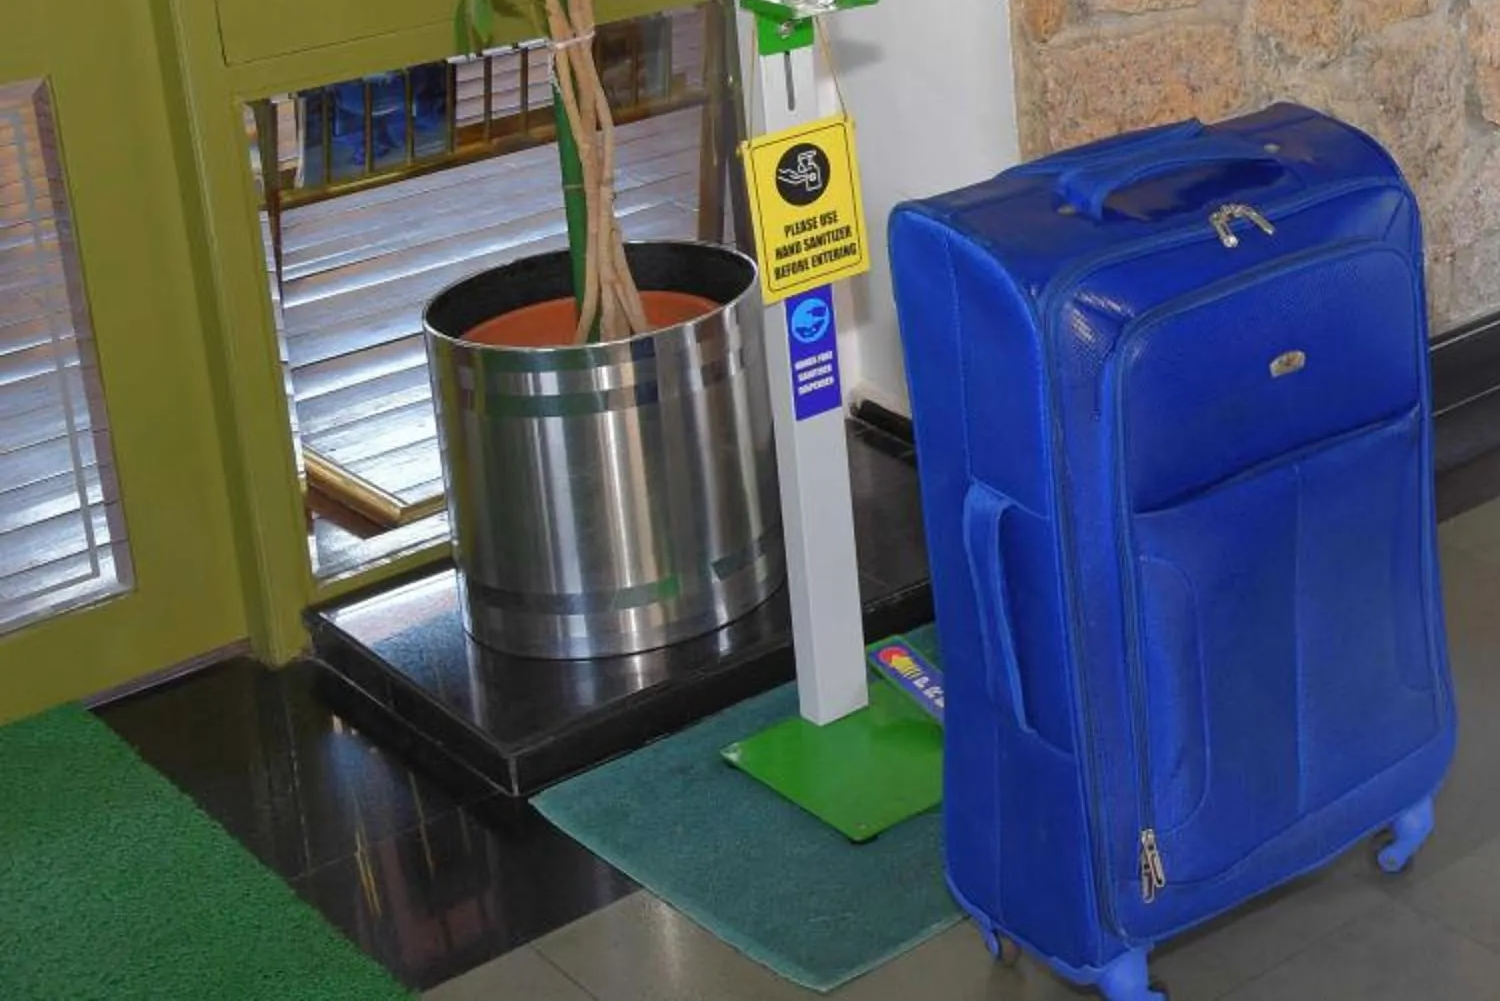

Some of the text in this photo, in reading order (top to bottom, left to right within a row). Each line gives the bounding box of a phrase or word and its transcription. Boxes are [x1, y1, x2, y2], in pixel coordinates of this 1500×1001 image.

[775, 224, 853, 261] HAND SANITIZER
[783, 210, 837, 238] PLEASE USE
[774, 242, 857, 281] BEFORE ENTERING
